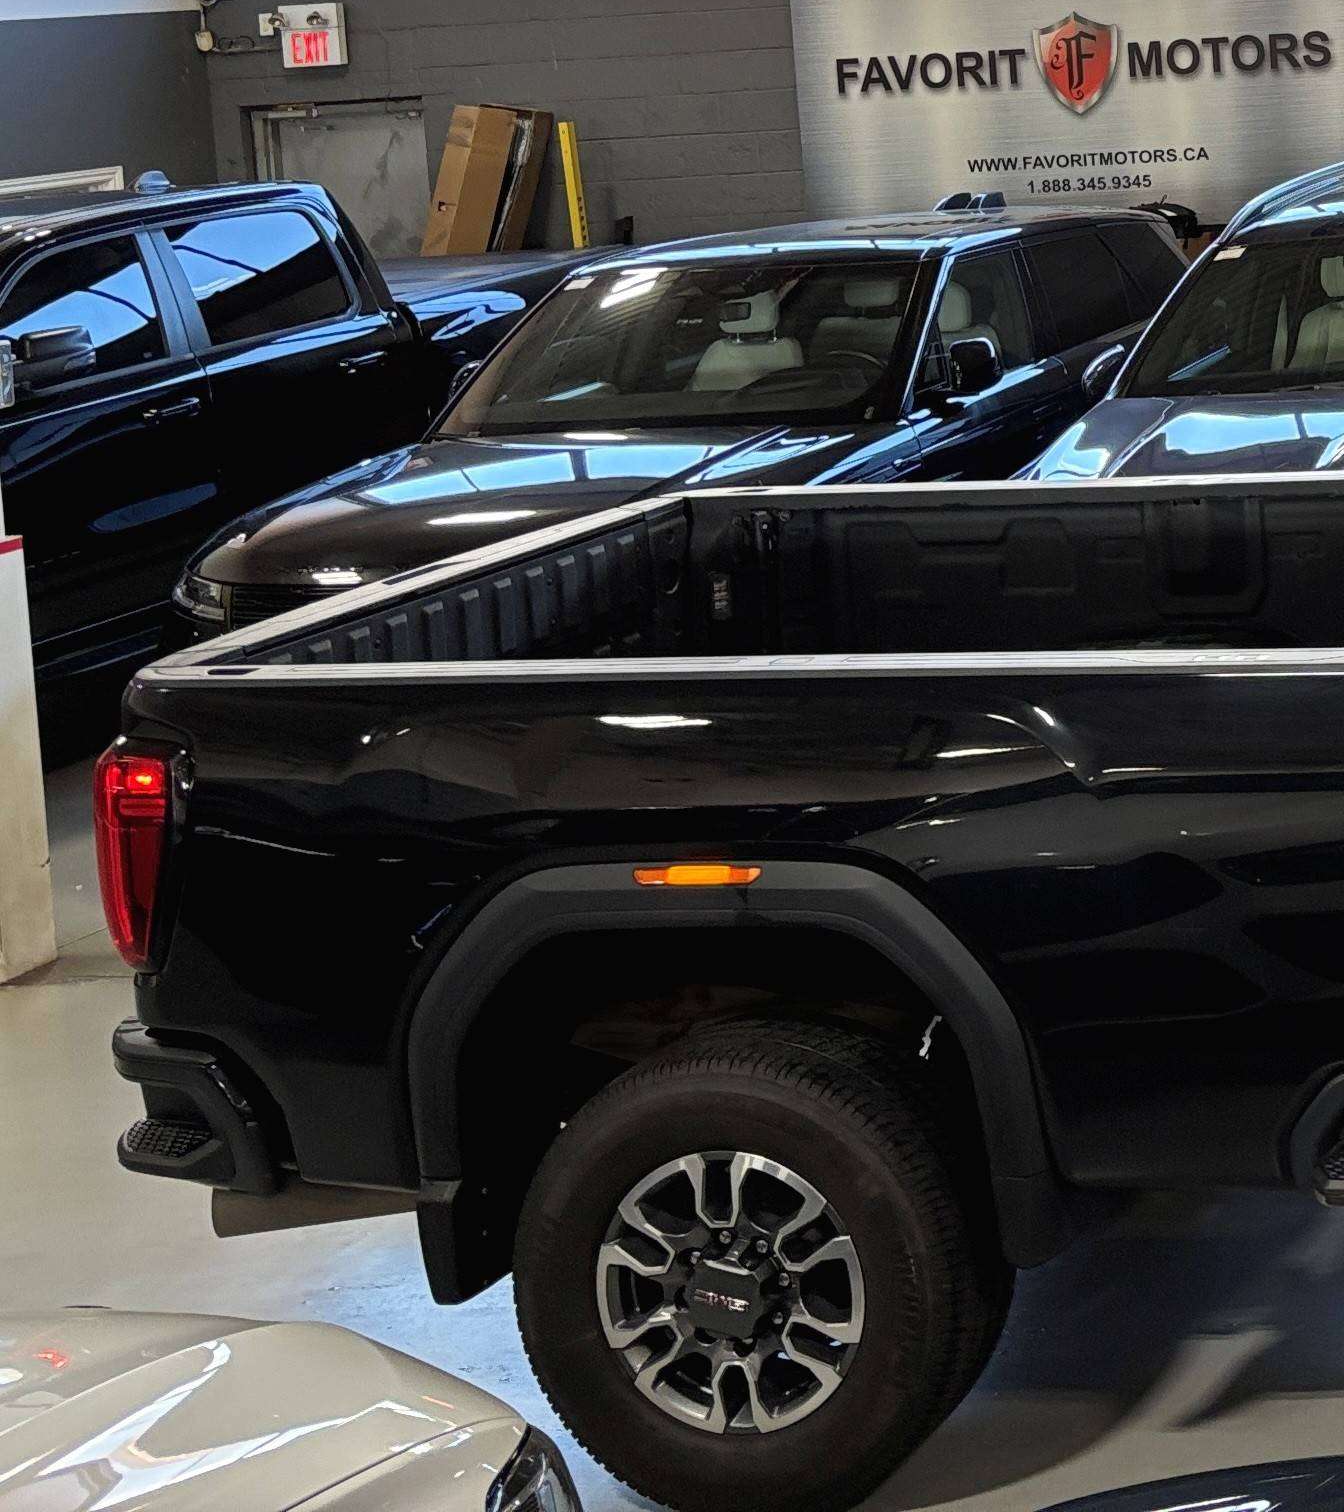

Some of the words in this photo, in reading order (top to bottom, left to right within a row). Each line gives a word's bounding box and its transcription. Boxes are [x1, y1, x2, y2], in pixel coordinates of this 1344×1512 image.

[291, 31, 330, 64] EXIT
[836, 48, 1026, 94] FAVORIT
[1127, 30, 1332, 78] MOTORS
[967, 147, 1209, 173] WWW.FAVORITMOTORS.CA
[1027, 174, 1152, 194] 1.888.345.9345
